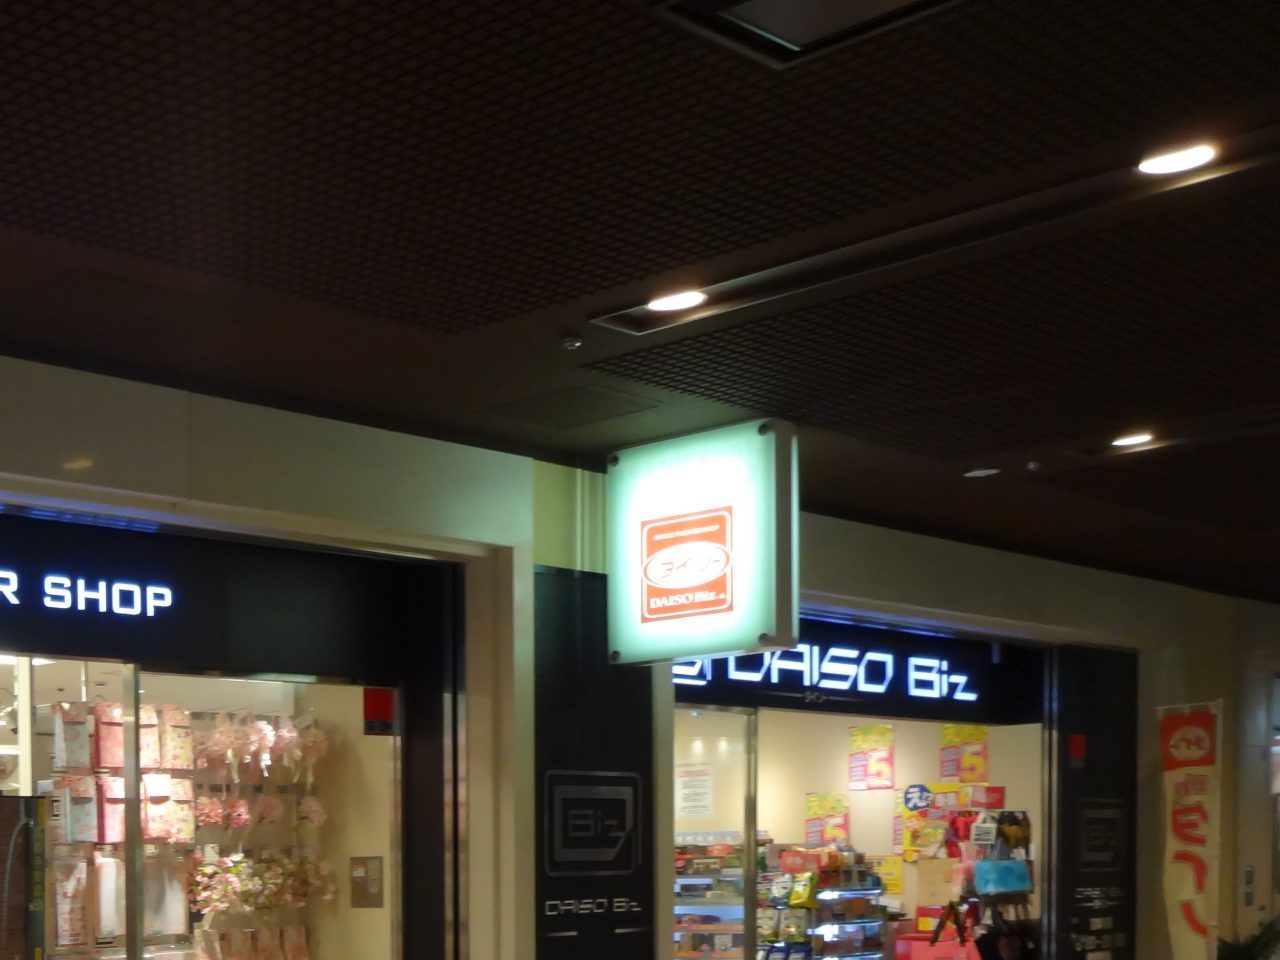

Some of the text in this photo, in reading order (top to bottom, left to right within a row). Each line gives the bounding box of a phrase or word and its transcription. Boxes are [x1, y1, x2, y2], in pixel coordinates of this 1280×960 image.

[42, 574, 174, 617] SHOP
[649, 593, 693, 609] DAISO
[727, 643, 978, 701] DAISO Biz
[568, 809, 627, 837] Biz
[545, 898, 643, 916] DAISO Biz
